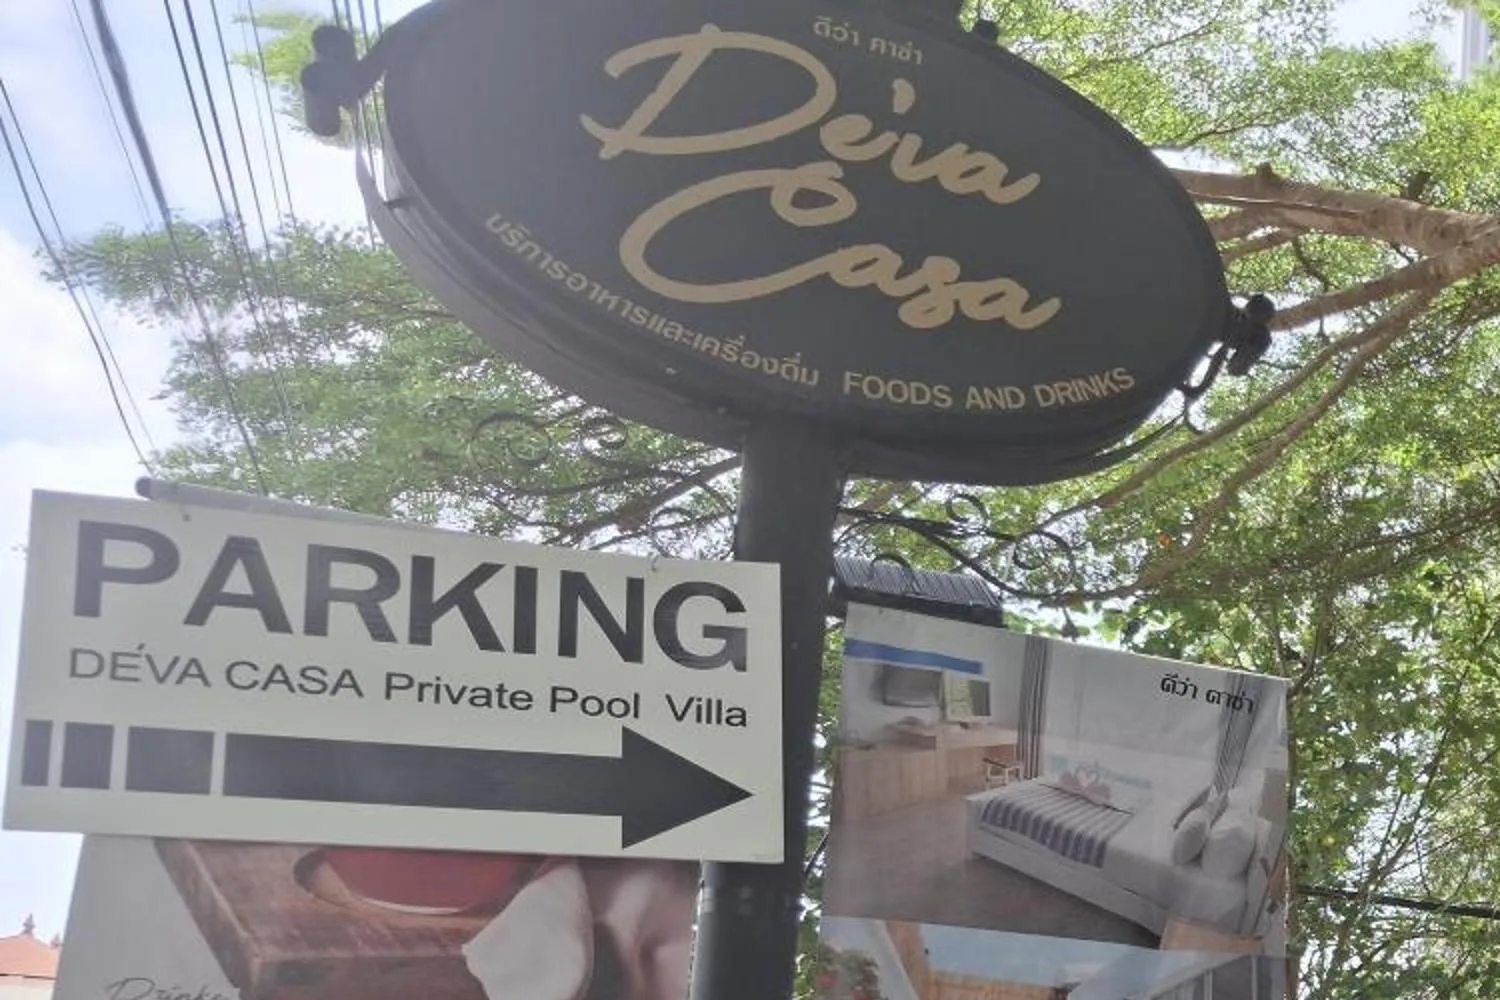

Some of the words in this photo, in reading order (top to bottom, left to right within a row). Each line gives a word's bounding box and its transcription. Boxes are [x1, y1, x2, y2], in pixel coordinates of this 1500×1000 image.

[484, 212, 820, 387] บริการอาหารและเครื่องดื่ม
[619, 161, 1061, 329] Casa
[842, 370, 953, 408] FOODS
[964, 385, 1026, 410] AND
[1034, 367, 1136, 408] DRINKS
[73, 520, 748, 673] PARKING
[225, 660, 364, 699] CASA
[384, 671, 534, 711] Private
[549, 685, 641, 719] Pool
[665, 694, 748, 728] Villa
